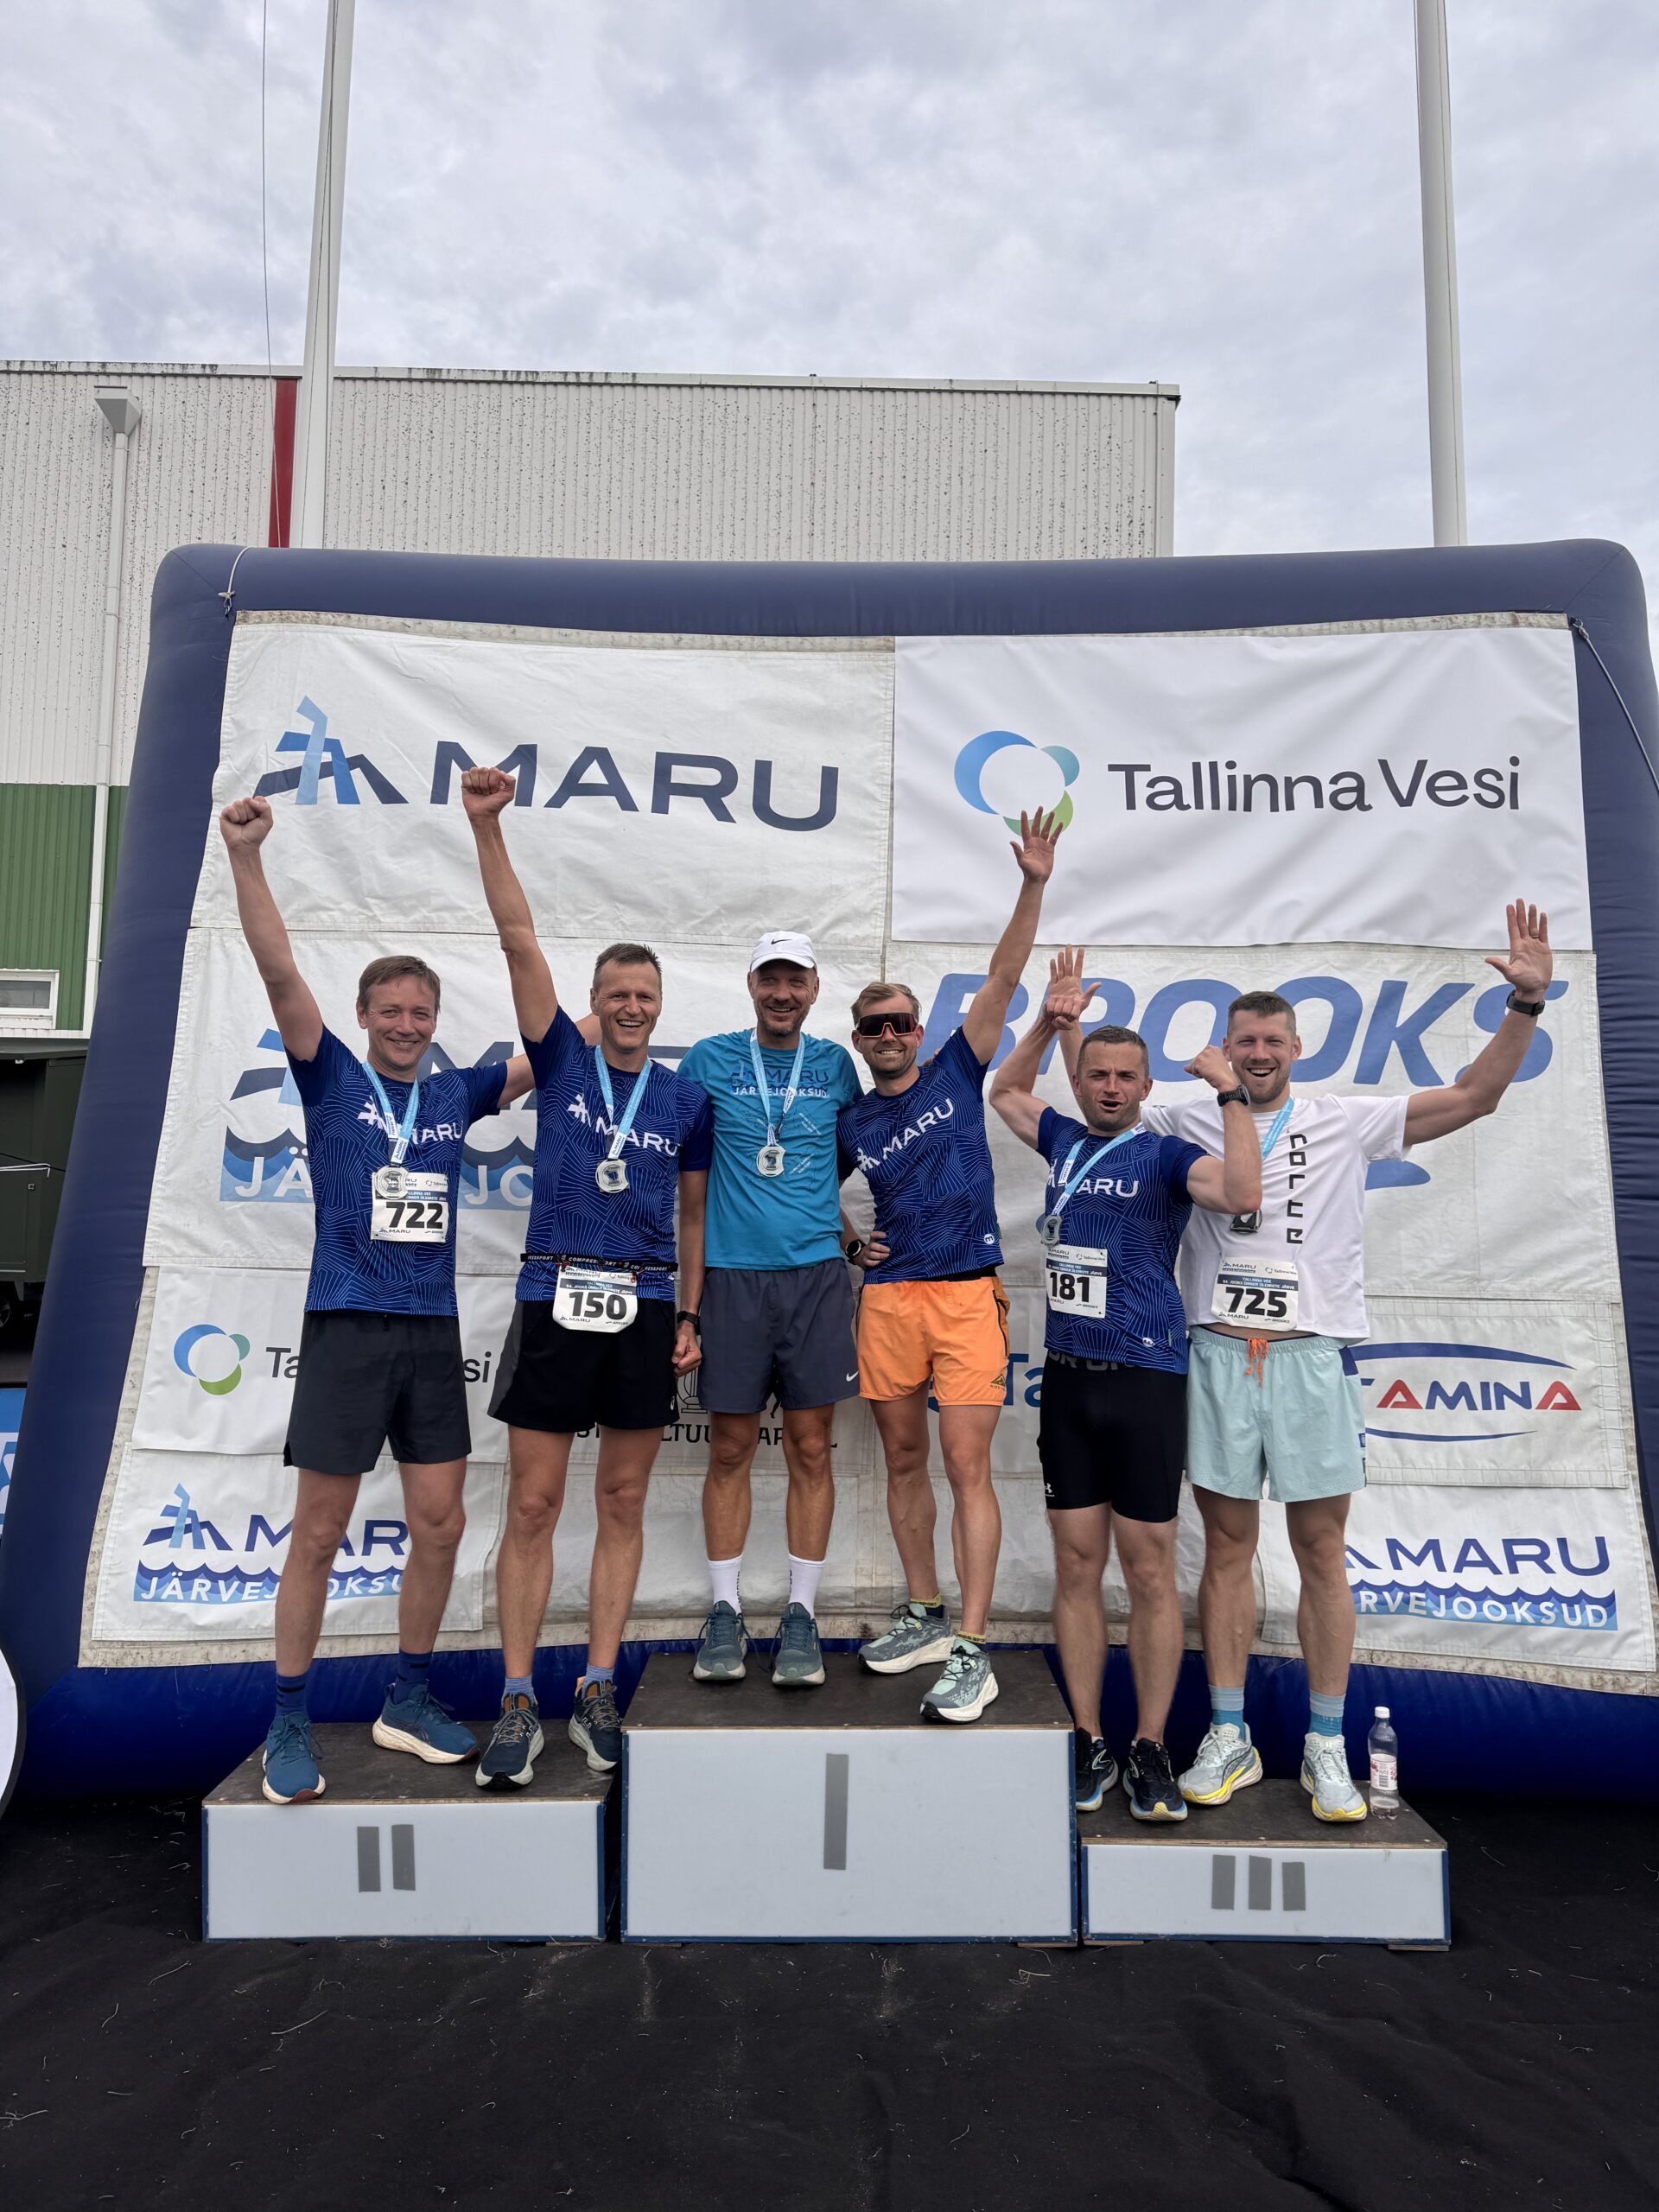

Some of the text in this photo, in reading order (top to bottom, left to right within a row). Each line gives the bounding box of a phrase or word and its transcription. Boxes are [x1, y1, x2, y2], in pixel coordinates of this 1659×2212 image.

[430, 741, 839, 831] MARU
[1108, 756, 1520, 813] Tallinna Vesi
[733, 1084, 827, 1098] JÄREJOKSUD
[882, 1097, 954, 1160] MARU
[1076, 1179, 1139, 1198] ARU
[386, 1201, 443, 1229] 722
[1050, 1272, 1090, 1303] 181
[1225, 1287, 1287, 1318] 725
[569, 1292, 626, 1320] 150
[1360, 1378, 1582, 1411] AMINA
[1385, 1536, 1610, 1577] MARU
[1359, 1591, 1608, 1629] RVEJOOKSUD
